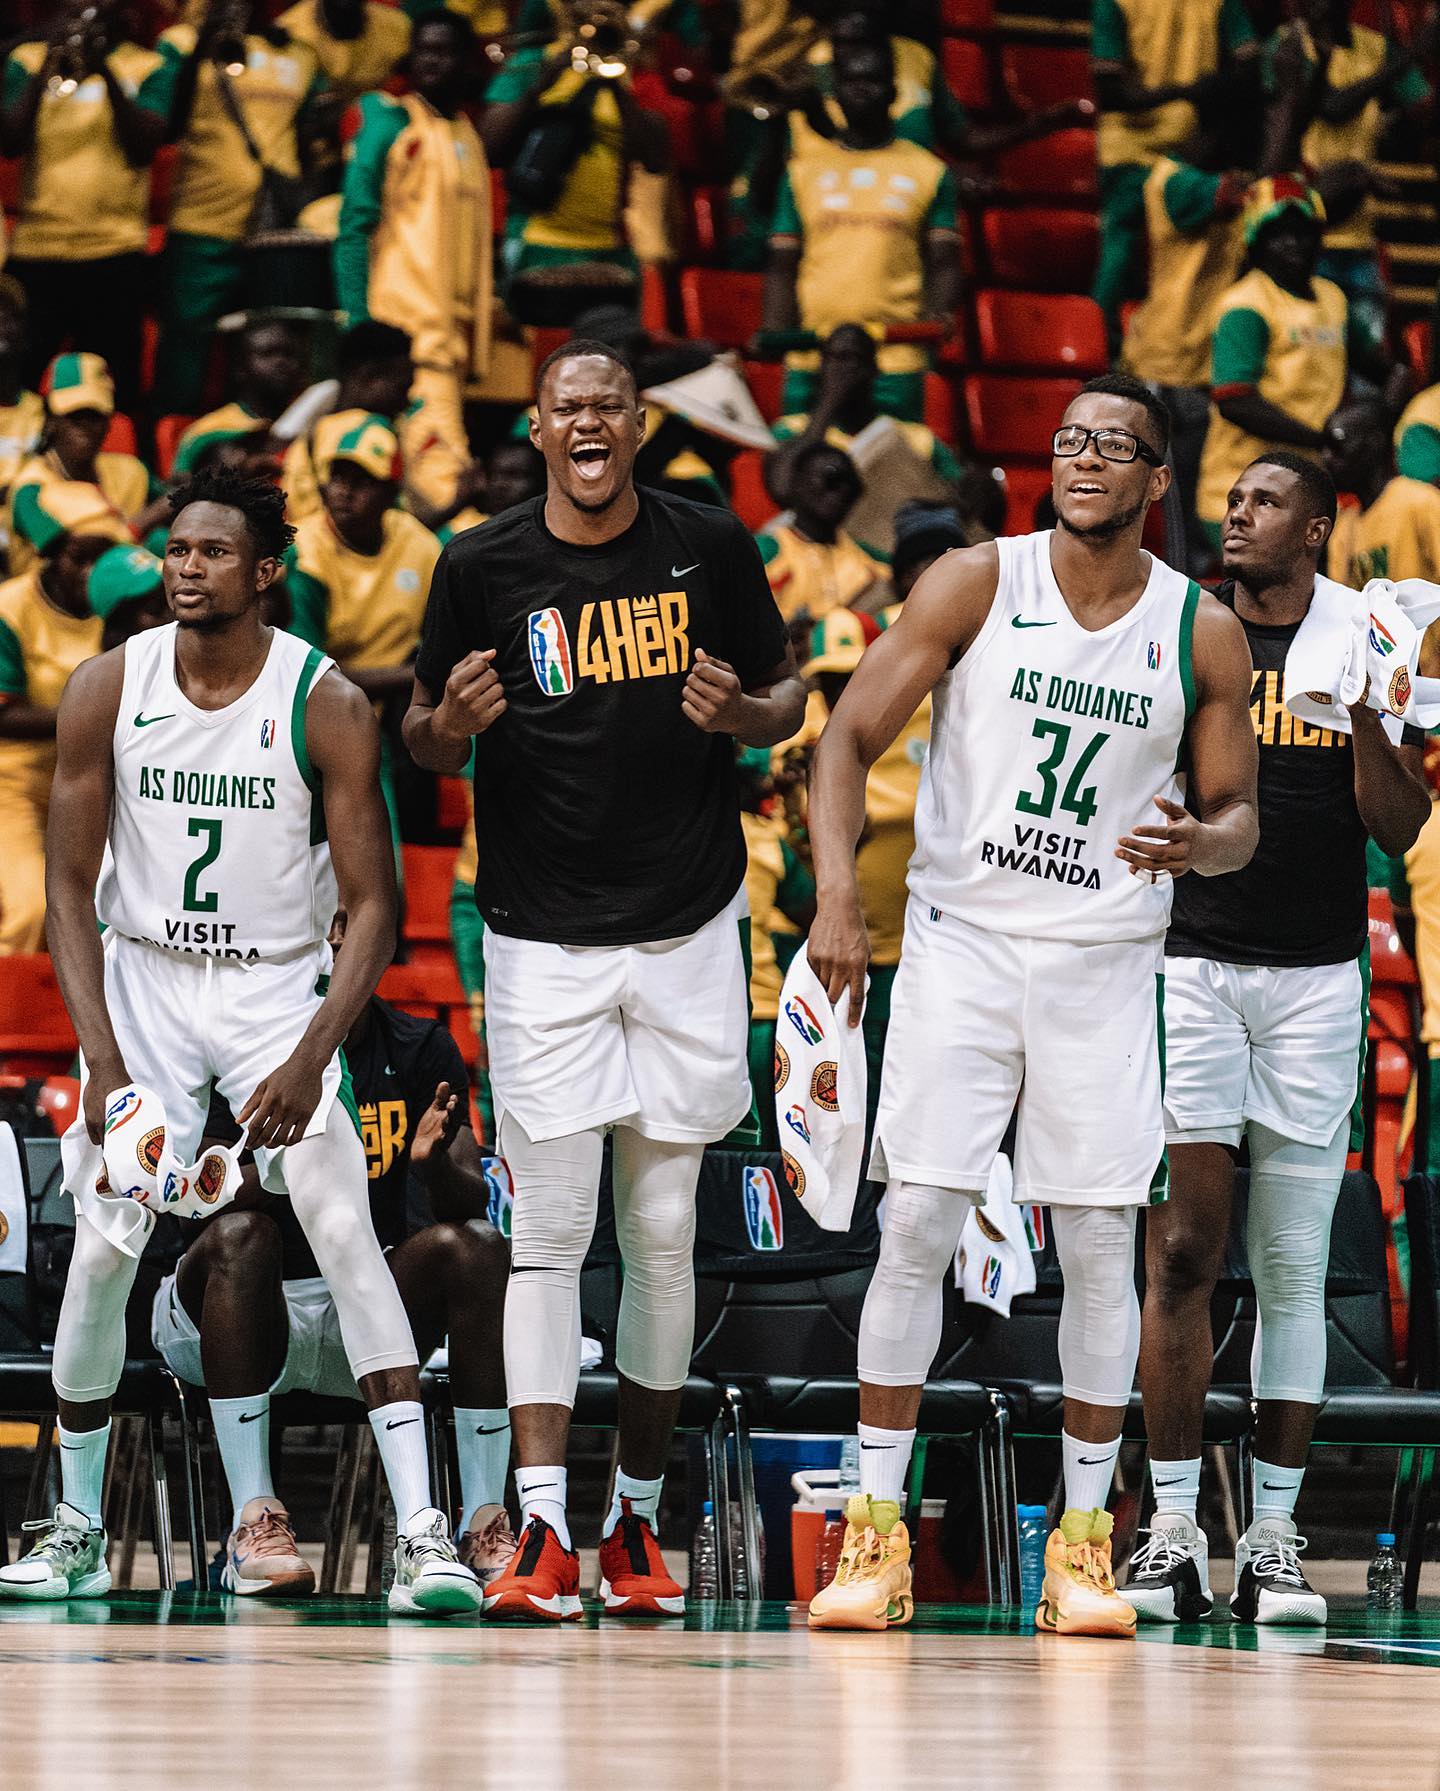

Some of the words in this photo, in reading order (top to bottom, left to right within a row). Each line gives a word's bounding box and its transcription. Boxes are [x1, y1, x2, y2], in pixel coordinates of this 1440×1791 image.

[532, 633, 545, 674] BAL
[1010, 667, 1043, 704] AS
[1046, 675, 1153, 729] DOUANES
[139, 766, 166, 800] AS
[173, 770, 276, 810] DOUANES
[1015, 717, 1111, 827] 34
[183, 817, 223, 912] 2
[1014, 823, 1087, 860] VISIT
[980, 841, 1101, 890] RWANDA
[165, 918, 236, 945] VISIT
